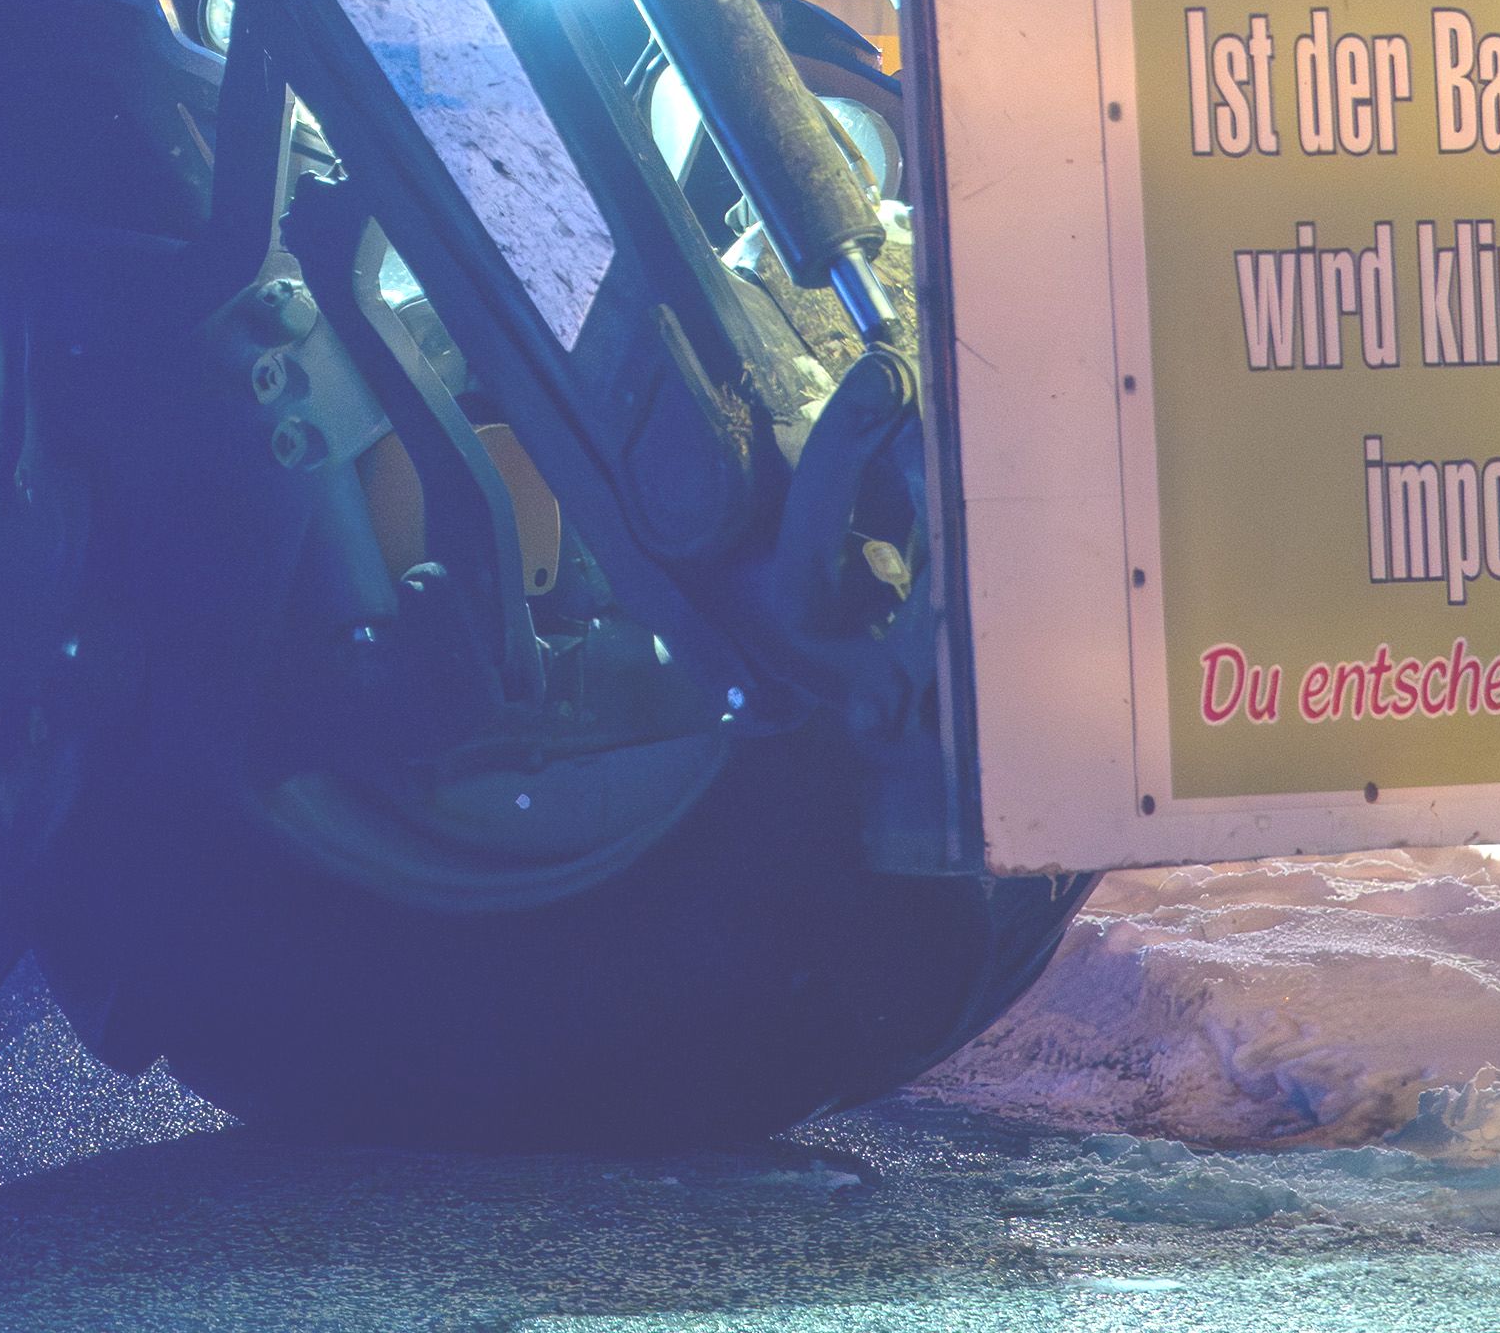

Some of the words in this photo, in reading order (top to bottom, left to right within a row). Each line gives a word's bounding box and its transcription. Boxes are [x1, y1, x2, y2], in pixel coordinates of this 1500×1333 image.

[1184, 6, 1280, 157] Ist
[1294, 7, 1412, 155] der
[1235, 221, 1399, 371] wird
[1200, 643, 1281, 725] Du
